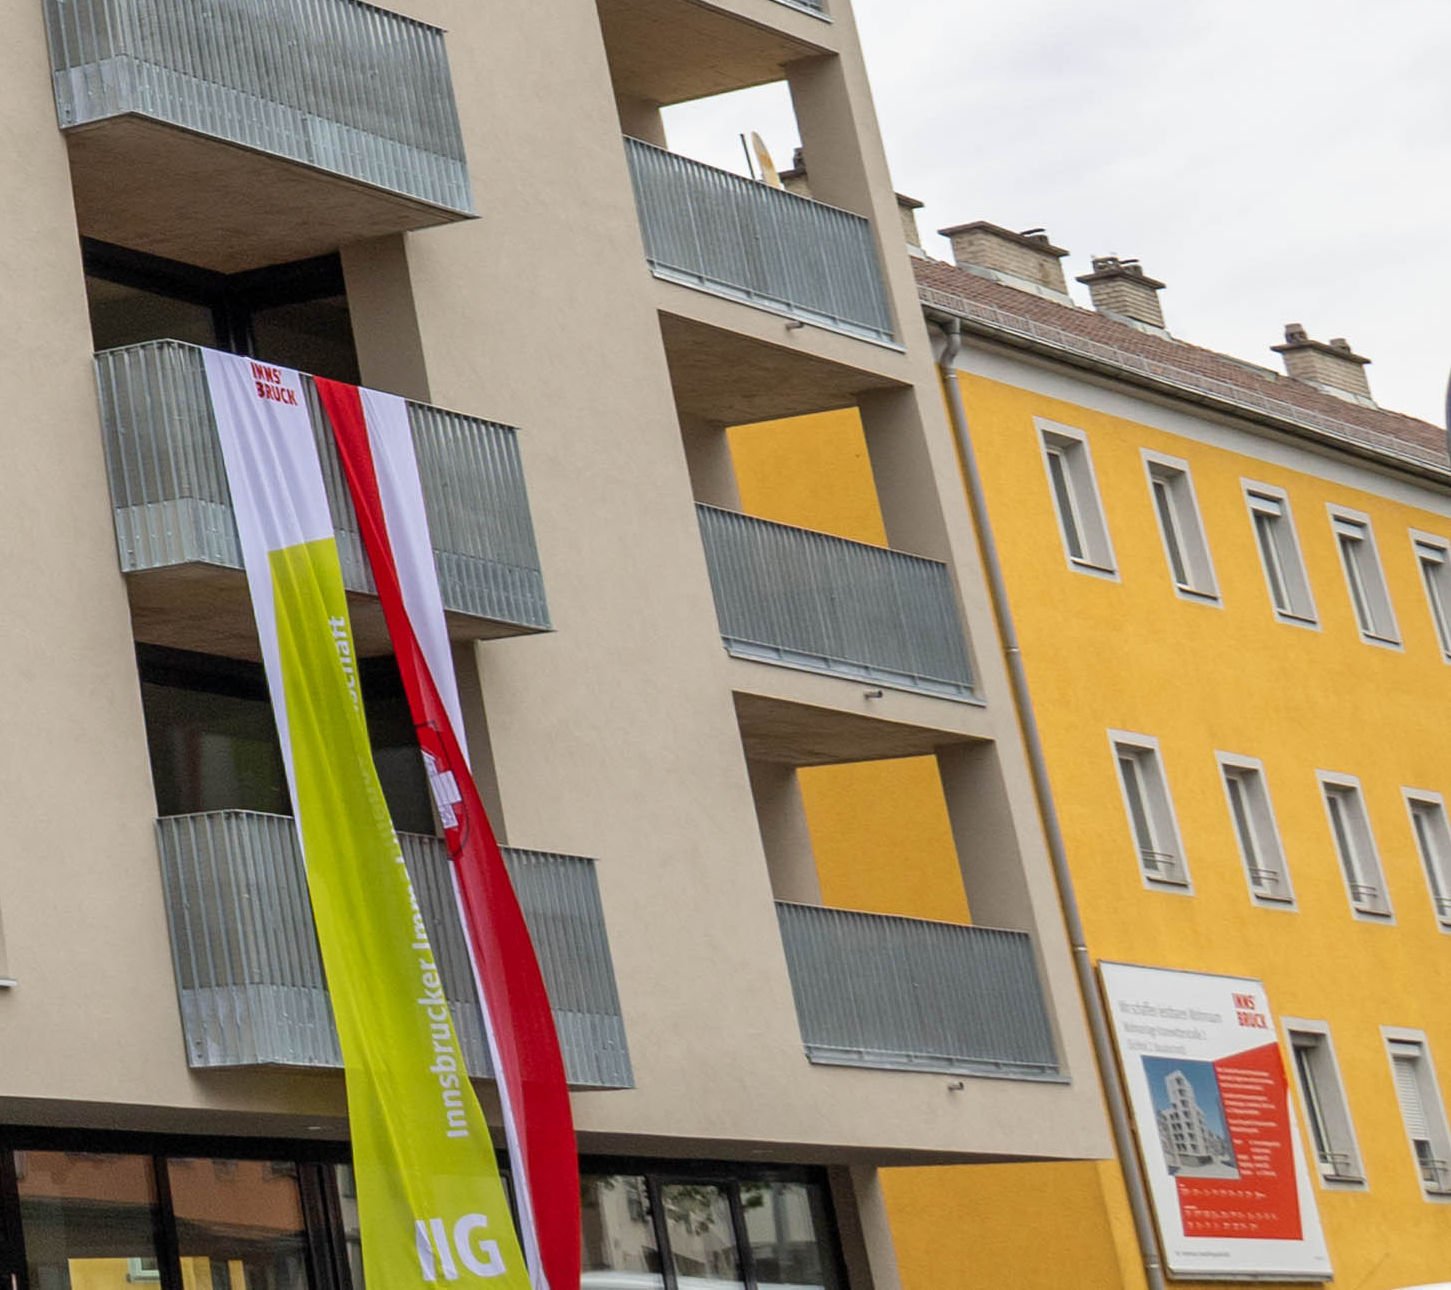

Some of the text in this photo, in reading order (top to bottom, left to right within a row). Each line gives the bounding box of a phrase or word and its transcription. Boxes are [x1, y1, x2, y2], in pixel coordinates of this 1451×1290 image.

[255, 380, 298, 406] BRUCK
[417, 957, 470, 1139] Innsbrucker
[414, 1212, 507, 1282] IIG
